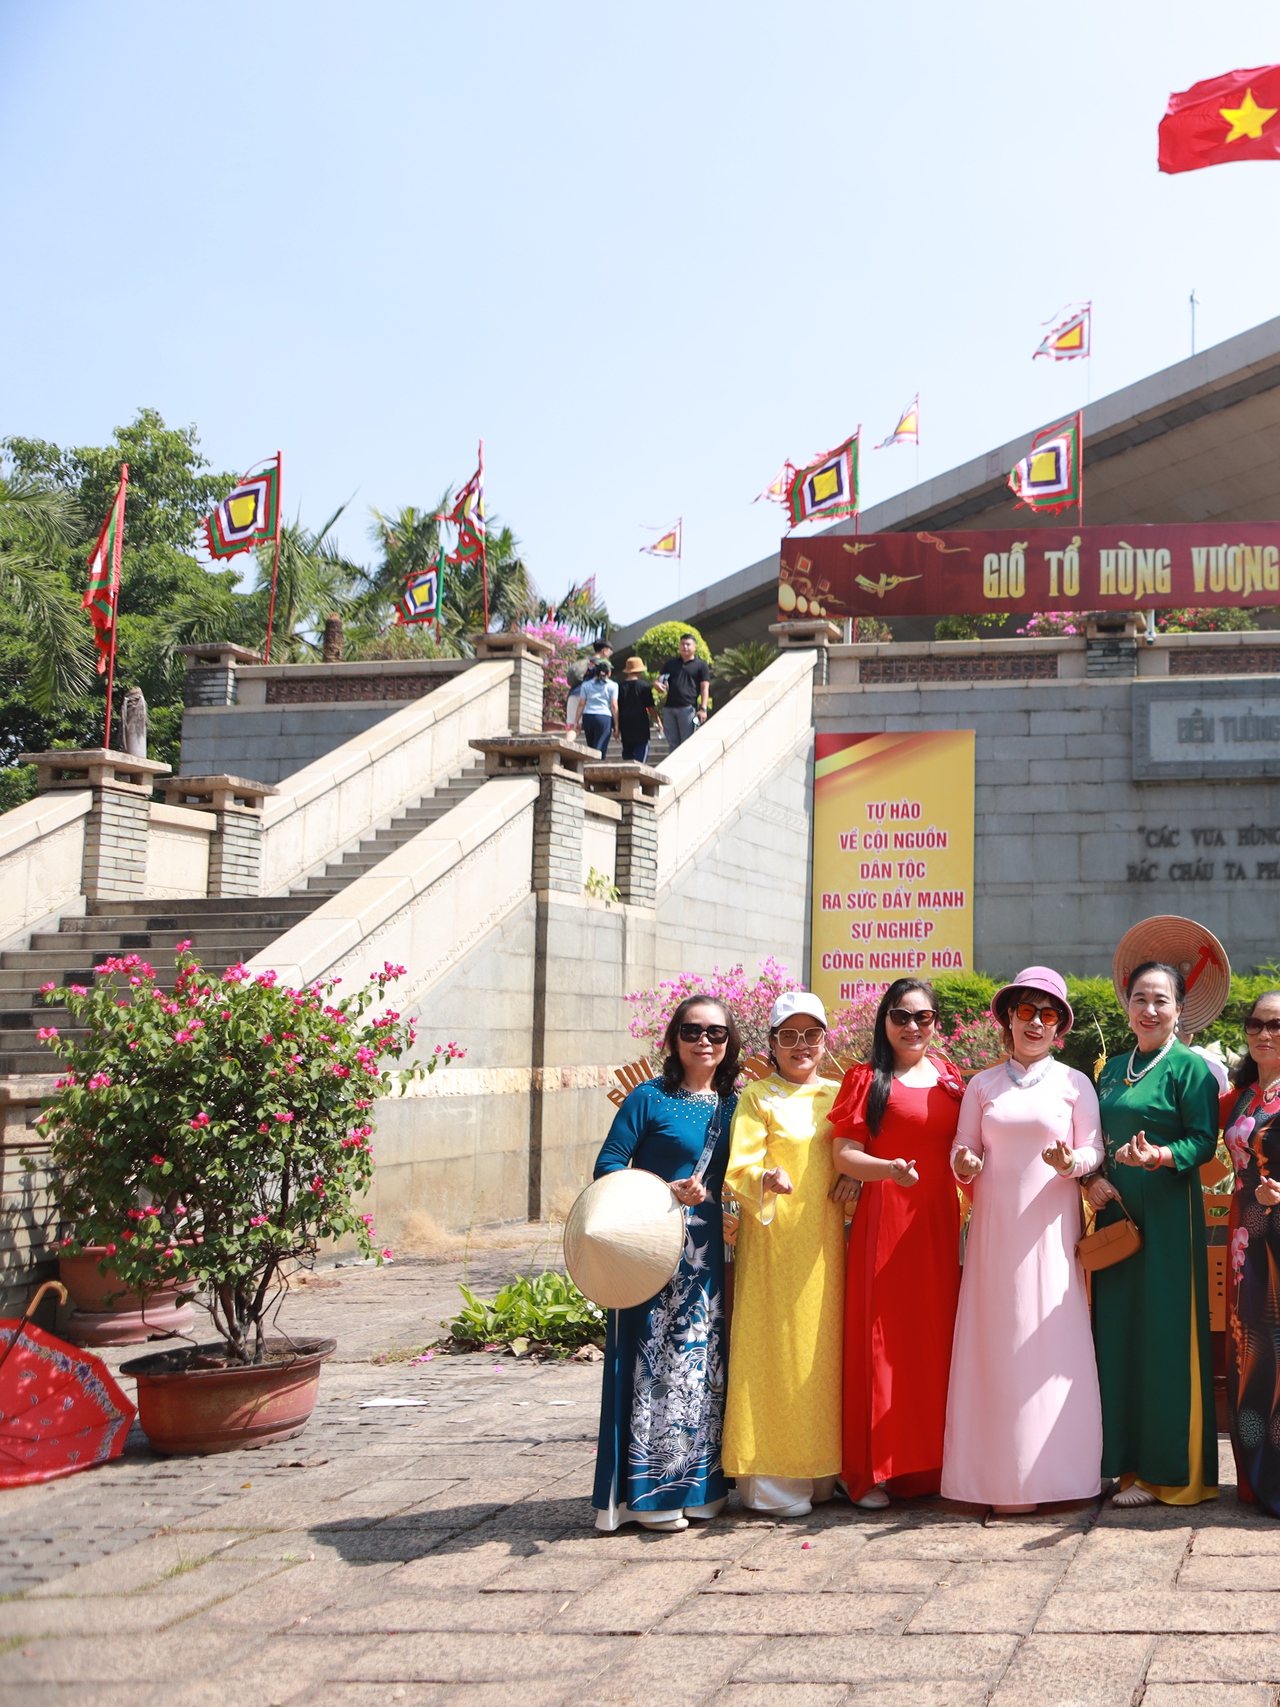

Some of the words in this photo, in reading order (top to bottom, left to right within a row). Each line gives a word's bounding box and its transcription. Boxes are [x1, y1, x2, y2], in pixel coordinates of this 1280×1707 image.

[983, 541, 1029, 599] GIỖ
[1044, 535, 1082, 597] TỔ
[1099, 541, 1172, 601] HÙNG
[1190, 543, 1280, 599] VƯƠNG
[867, 802, 887, 823] TỰ
[890, 800, 921, 819] HÀO
[839, 828, 858, 850] VỀ
[863, 830, 889, 853] CỘI
[893, 825, 948, 850] NGUỒN
[1191, 827, 1225, 846] VUA
[860, 860, 892, 880] DÂN
[897, 859, 926, 882] TỘC
[1127, 858, 1158, 882] BÁC
[1168, 857, 1214, 881] CHÁU
[1224, 863, 1246, 880] TA
[822, 892, 842, 910] RA
[847, 889, 877, 910] SỨC
[882, 885, 912, 909] ĐẨY
[917, 891, 965, 912] MẠNH
[851, 921, 873, 943] SỰ
[876, 918, 934, 942] NGHIỆP
[821, 950, 864, 970] CÔNG
[869, 948, 926, 972] NGHIỆP
[931, 948, 963, 968] HÓA
